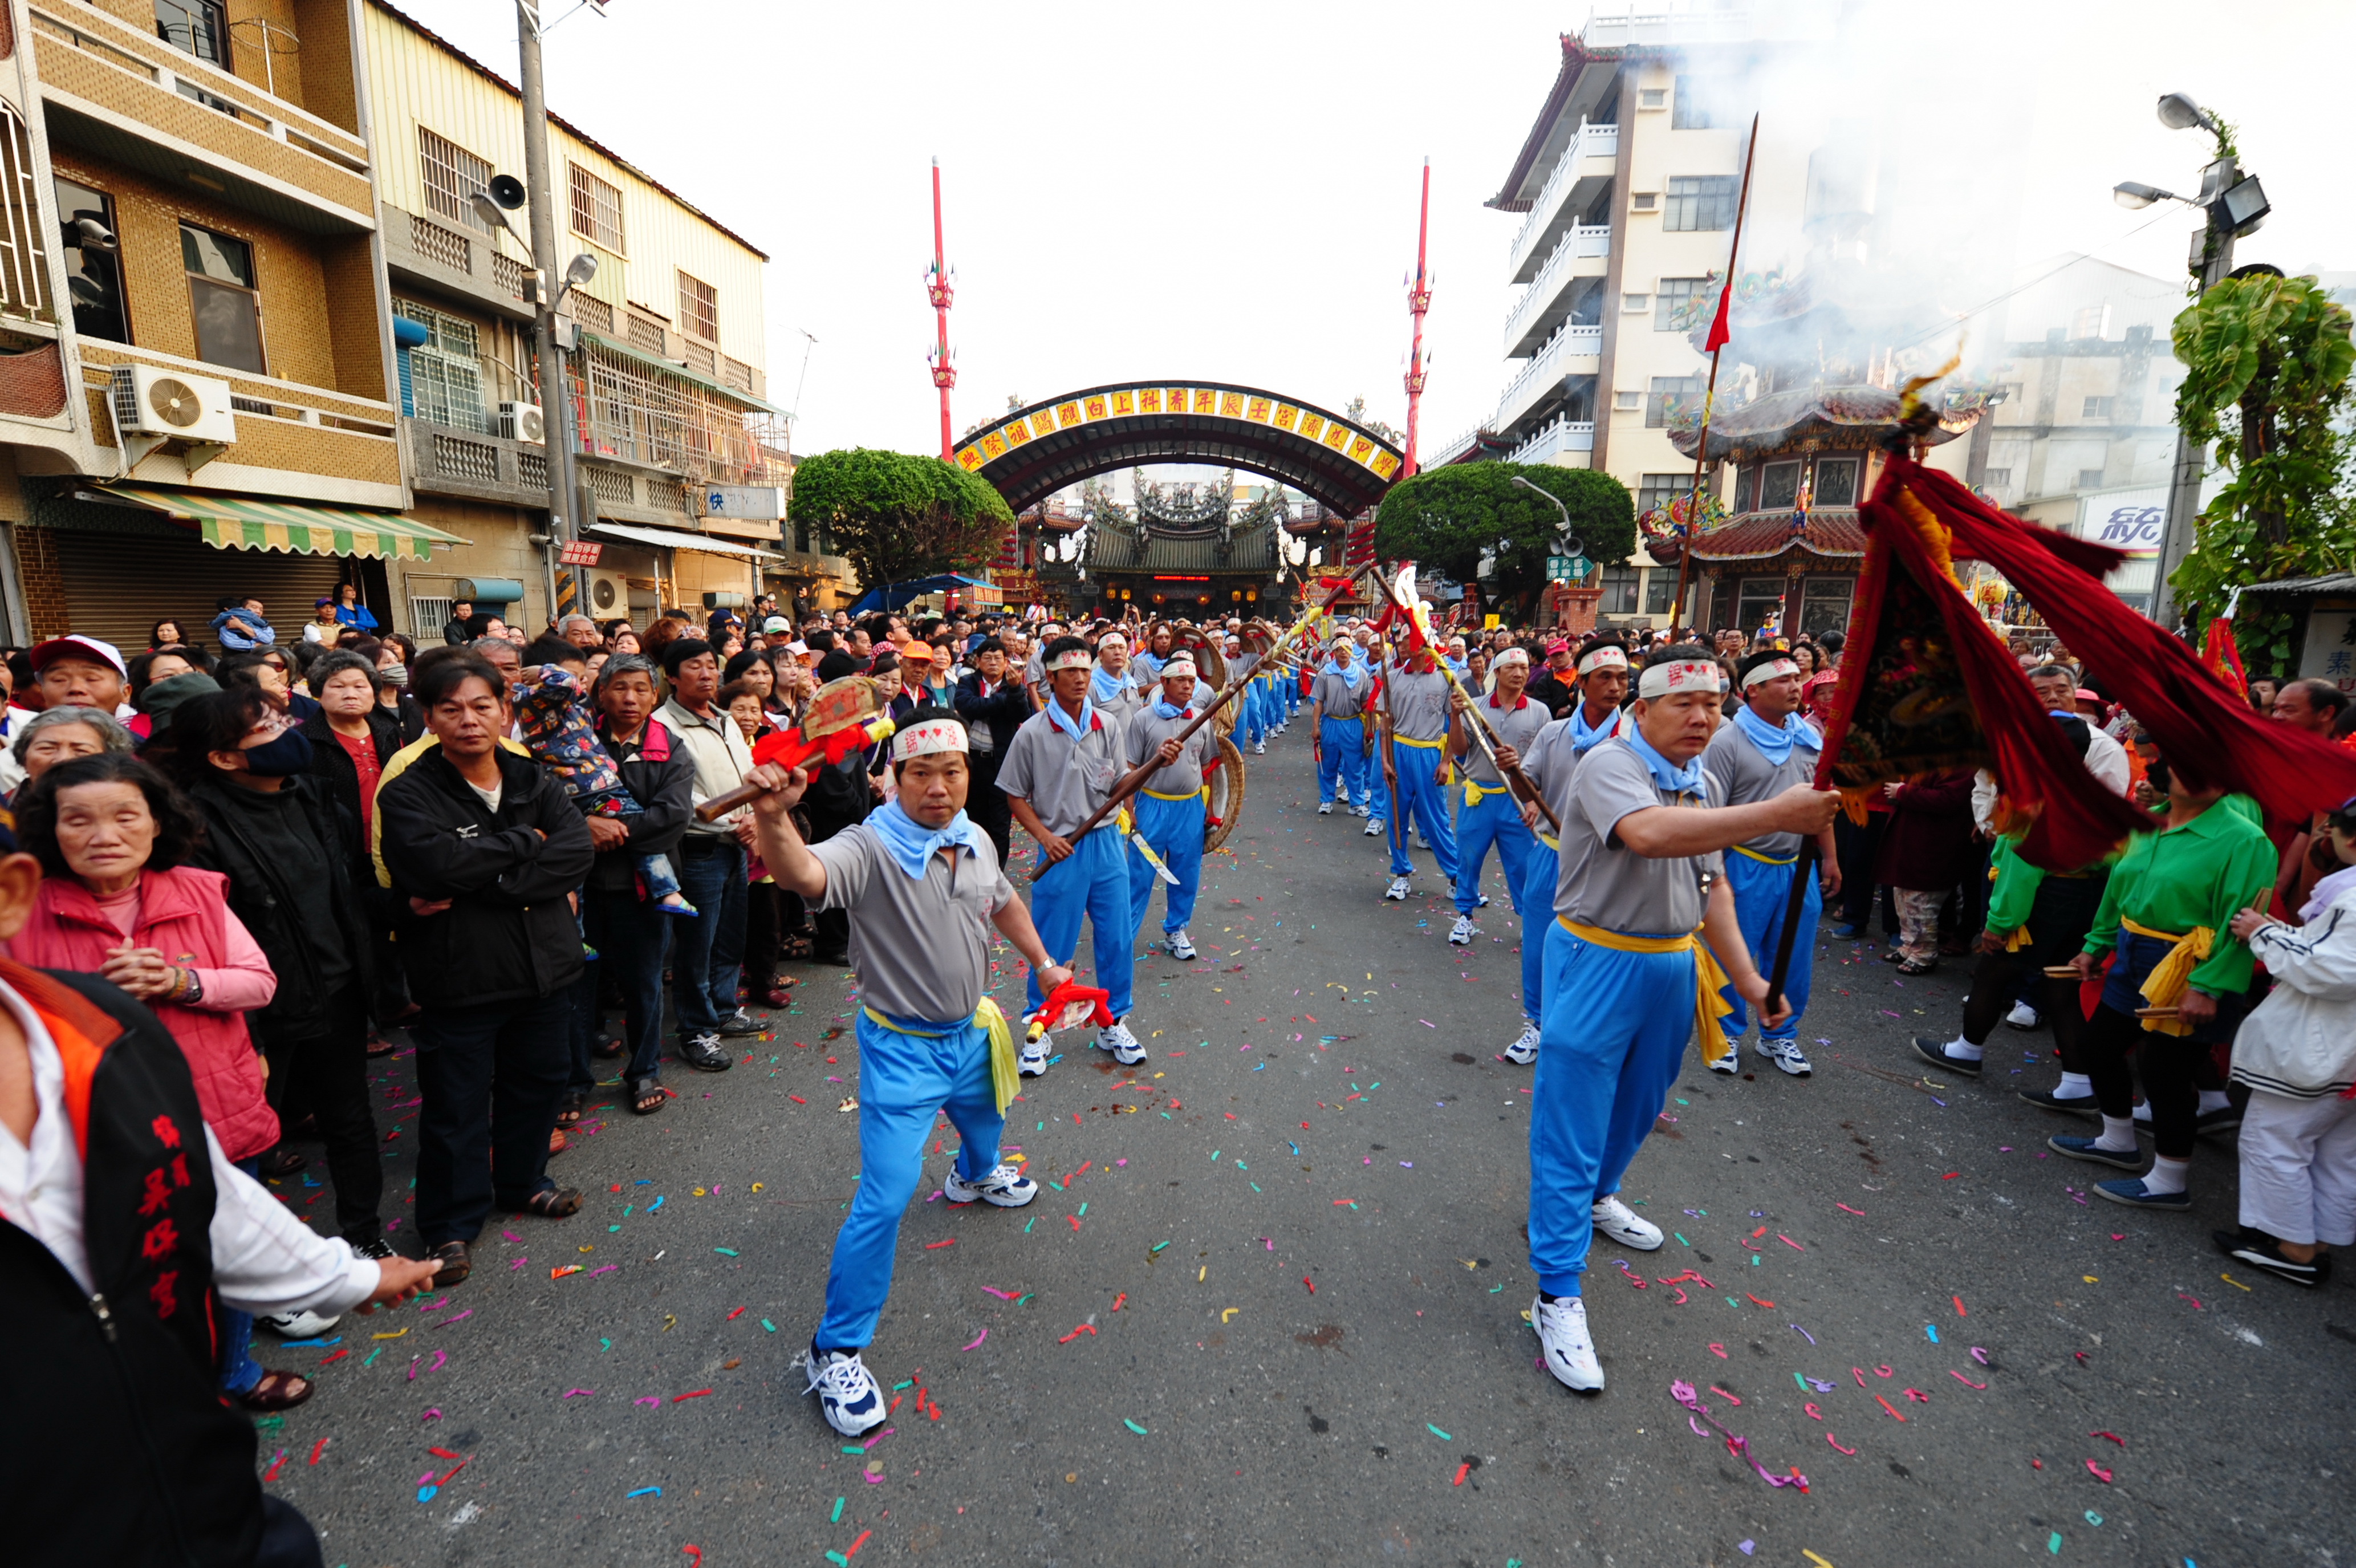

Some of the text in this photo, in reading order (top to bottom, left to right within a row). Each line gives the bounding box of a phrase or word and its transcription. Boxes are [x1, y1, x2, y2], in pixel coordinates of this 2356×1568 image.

[709, 491, 724, 510] 快
[2099, 507, 2163, 545] 統
[562, 552, 597, 563] 謝謝合作
[565, 543, 599, 554] 請勿停車
[1549, 568, 1583, 578] 停車場
[2326, 651, 2356, 675] 素
[1667, 663, 1684, 688] 錦
